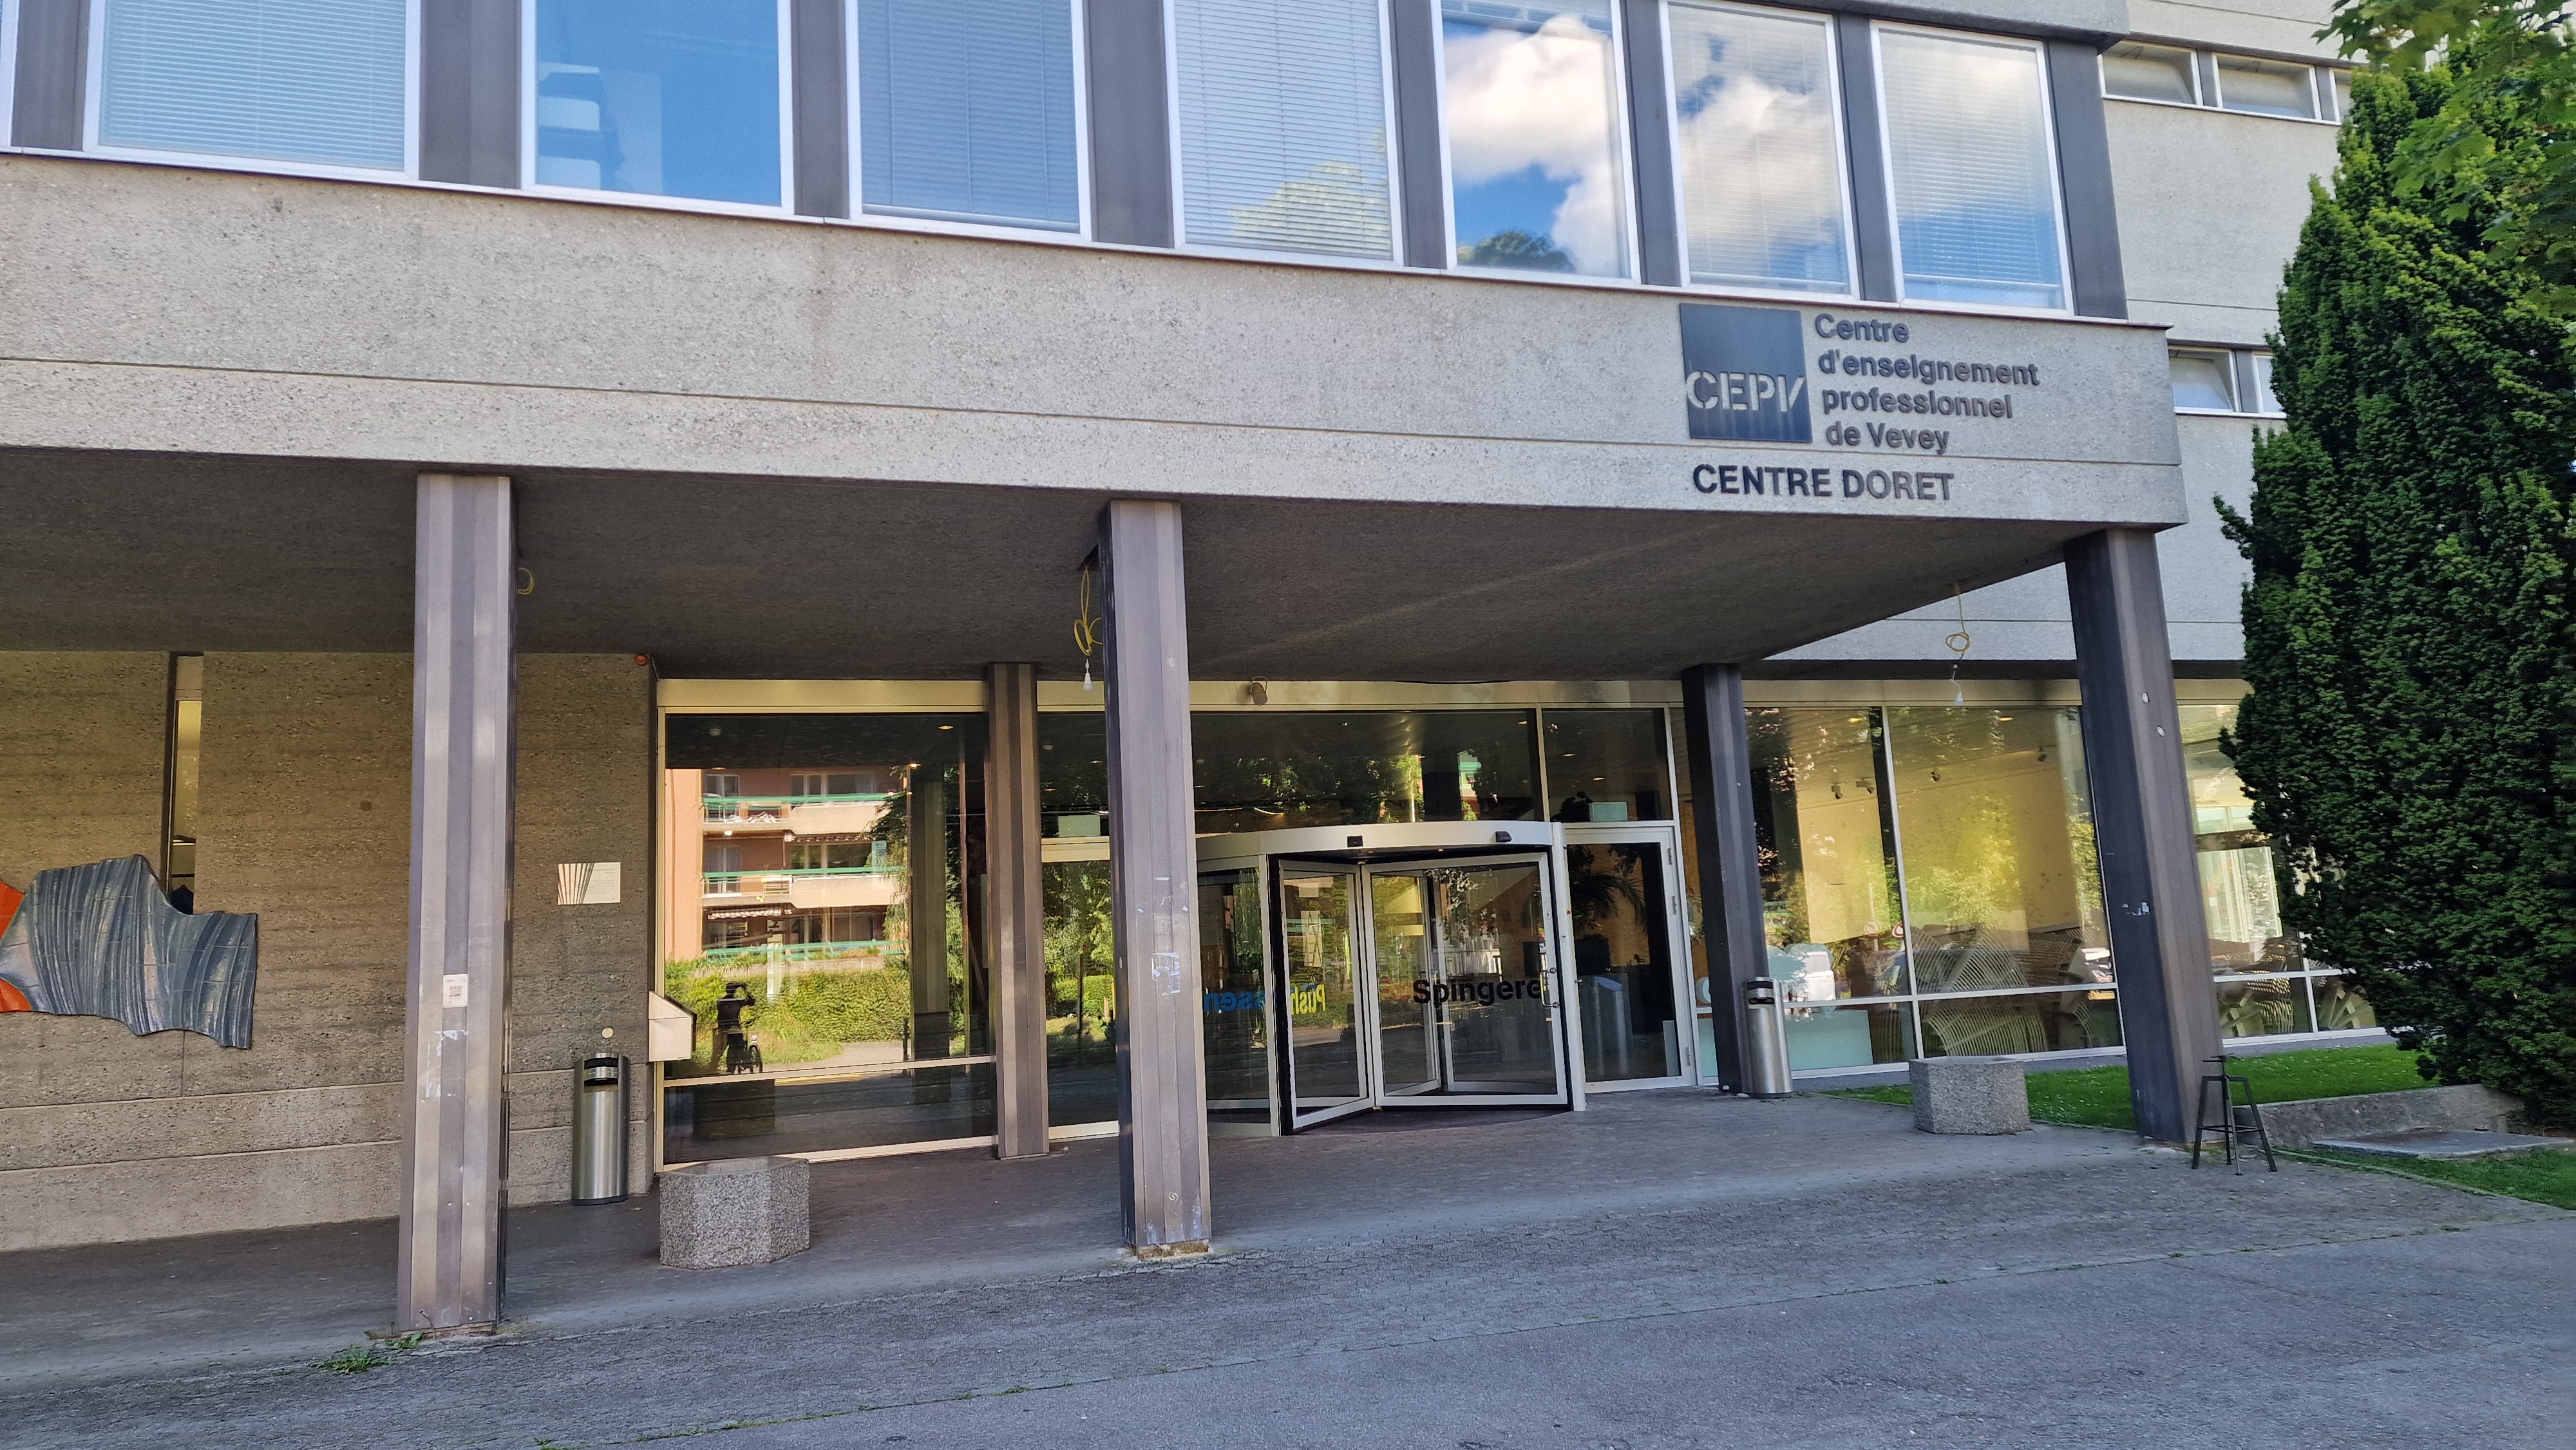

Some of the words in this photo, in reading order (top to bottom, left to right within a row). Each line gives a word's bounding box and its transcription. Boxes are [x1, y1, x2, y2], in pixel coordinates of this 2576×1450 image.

[1815, 313, 1910, 343] Centre
[1819, 349, 2040, 387] d'enseignement
[1685, 370, 1806, 412] CEPV
[1823, 386, 2013, 419] professionnel
[1826, 420, 1861, 446] de
[1867, 422, 1949, 455] Vevey
[1692, 464, 1833, 496] CENTRE
[1842, 469, 1955, 500] DORET
[1412, 979, 1542, 1007] Spingere
